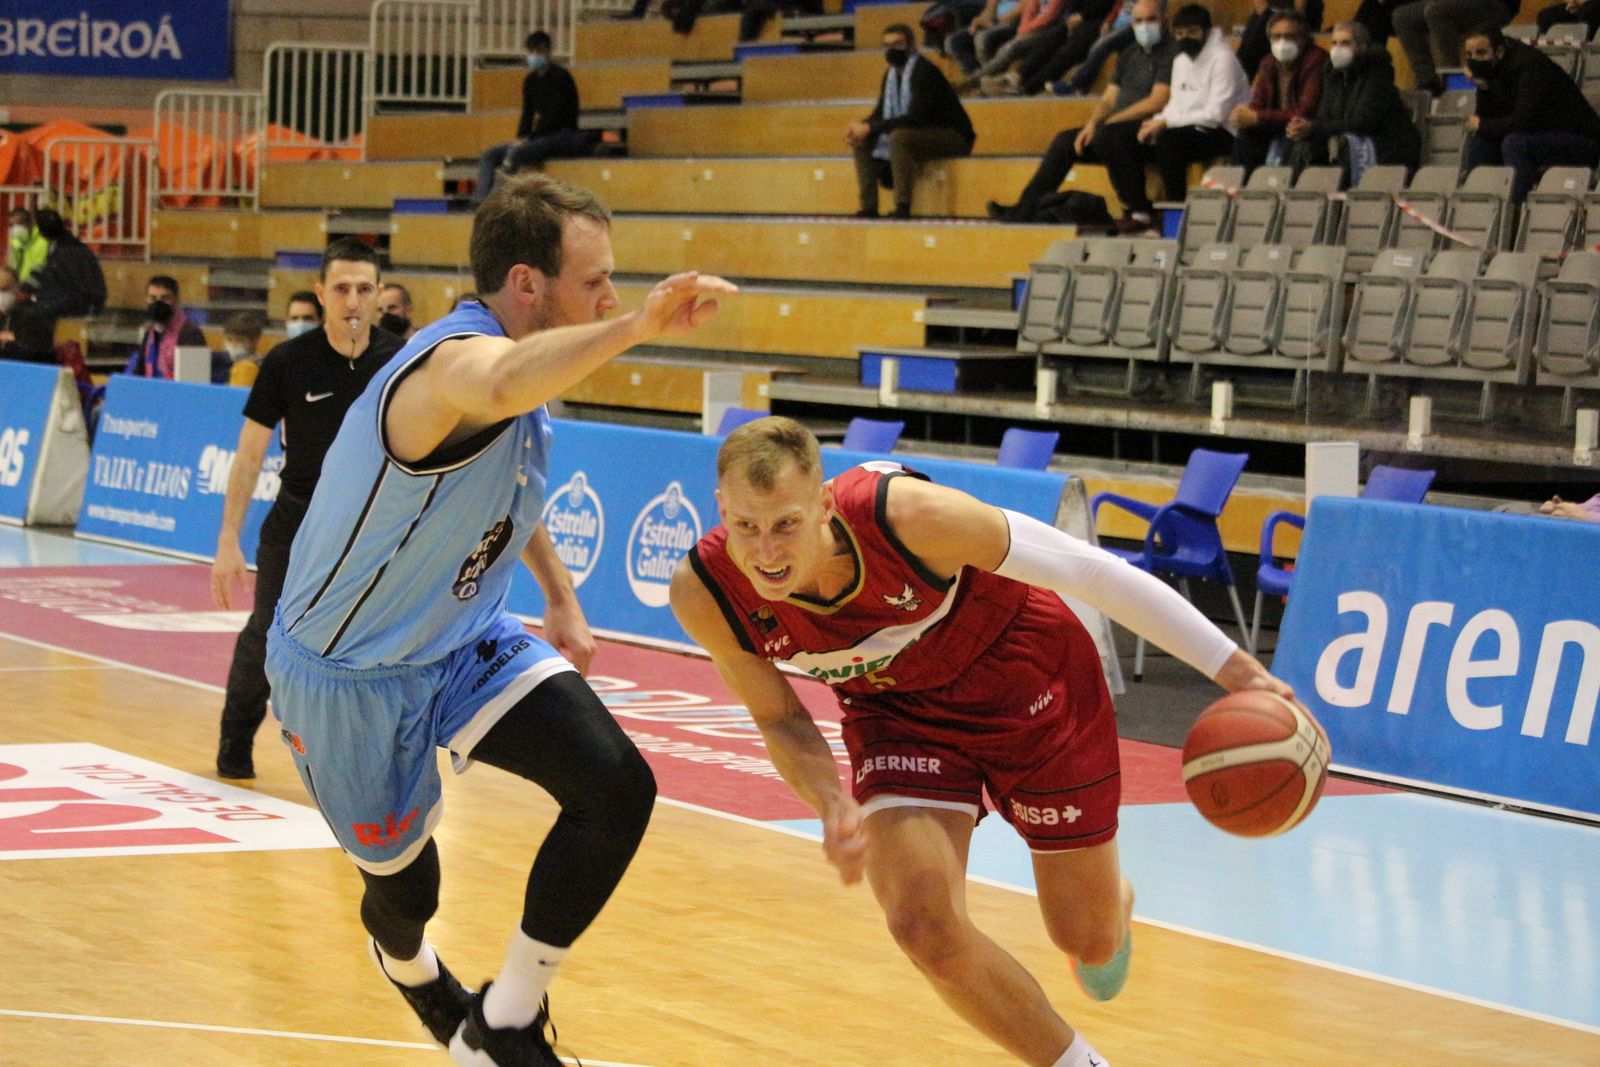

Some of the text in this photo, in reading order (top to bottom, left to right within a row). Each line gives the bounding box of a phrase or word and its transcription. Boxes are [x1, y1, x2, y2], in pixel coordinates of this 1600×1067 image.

[548, 505, 596, 538] Estrella
[640, 516, 694, 553] Estrella
[549, 535, 589, 568] alicia
[863, 755, 942, 776] BERNER
[59, 763, 223, 803] GALICIA
